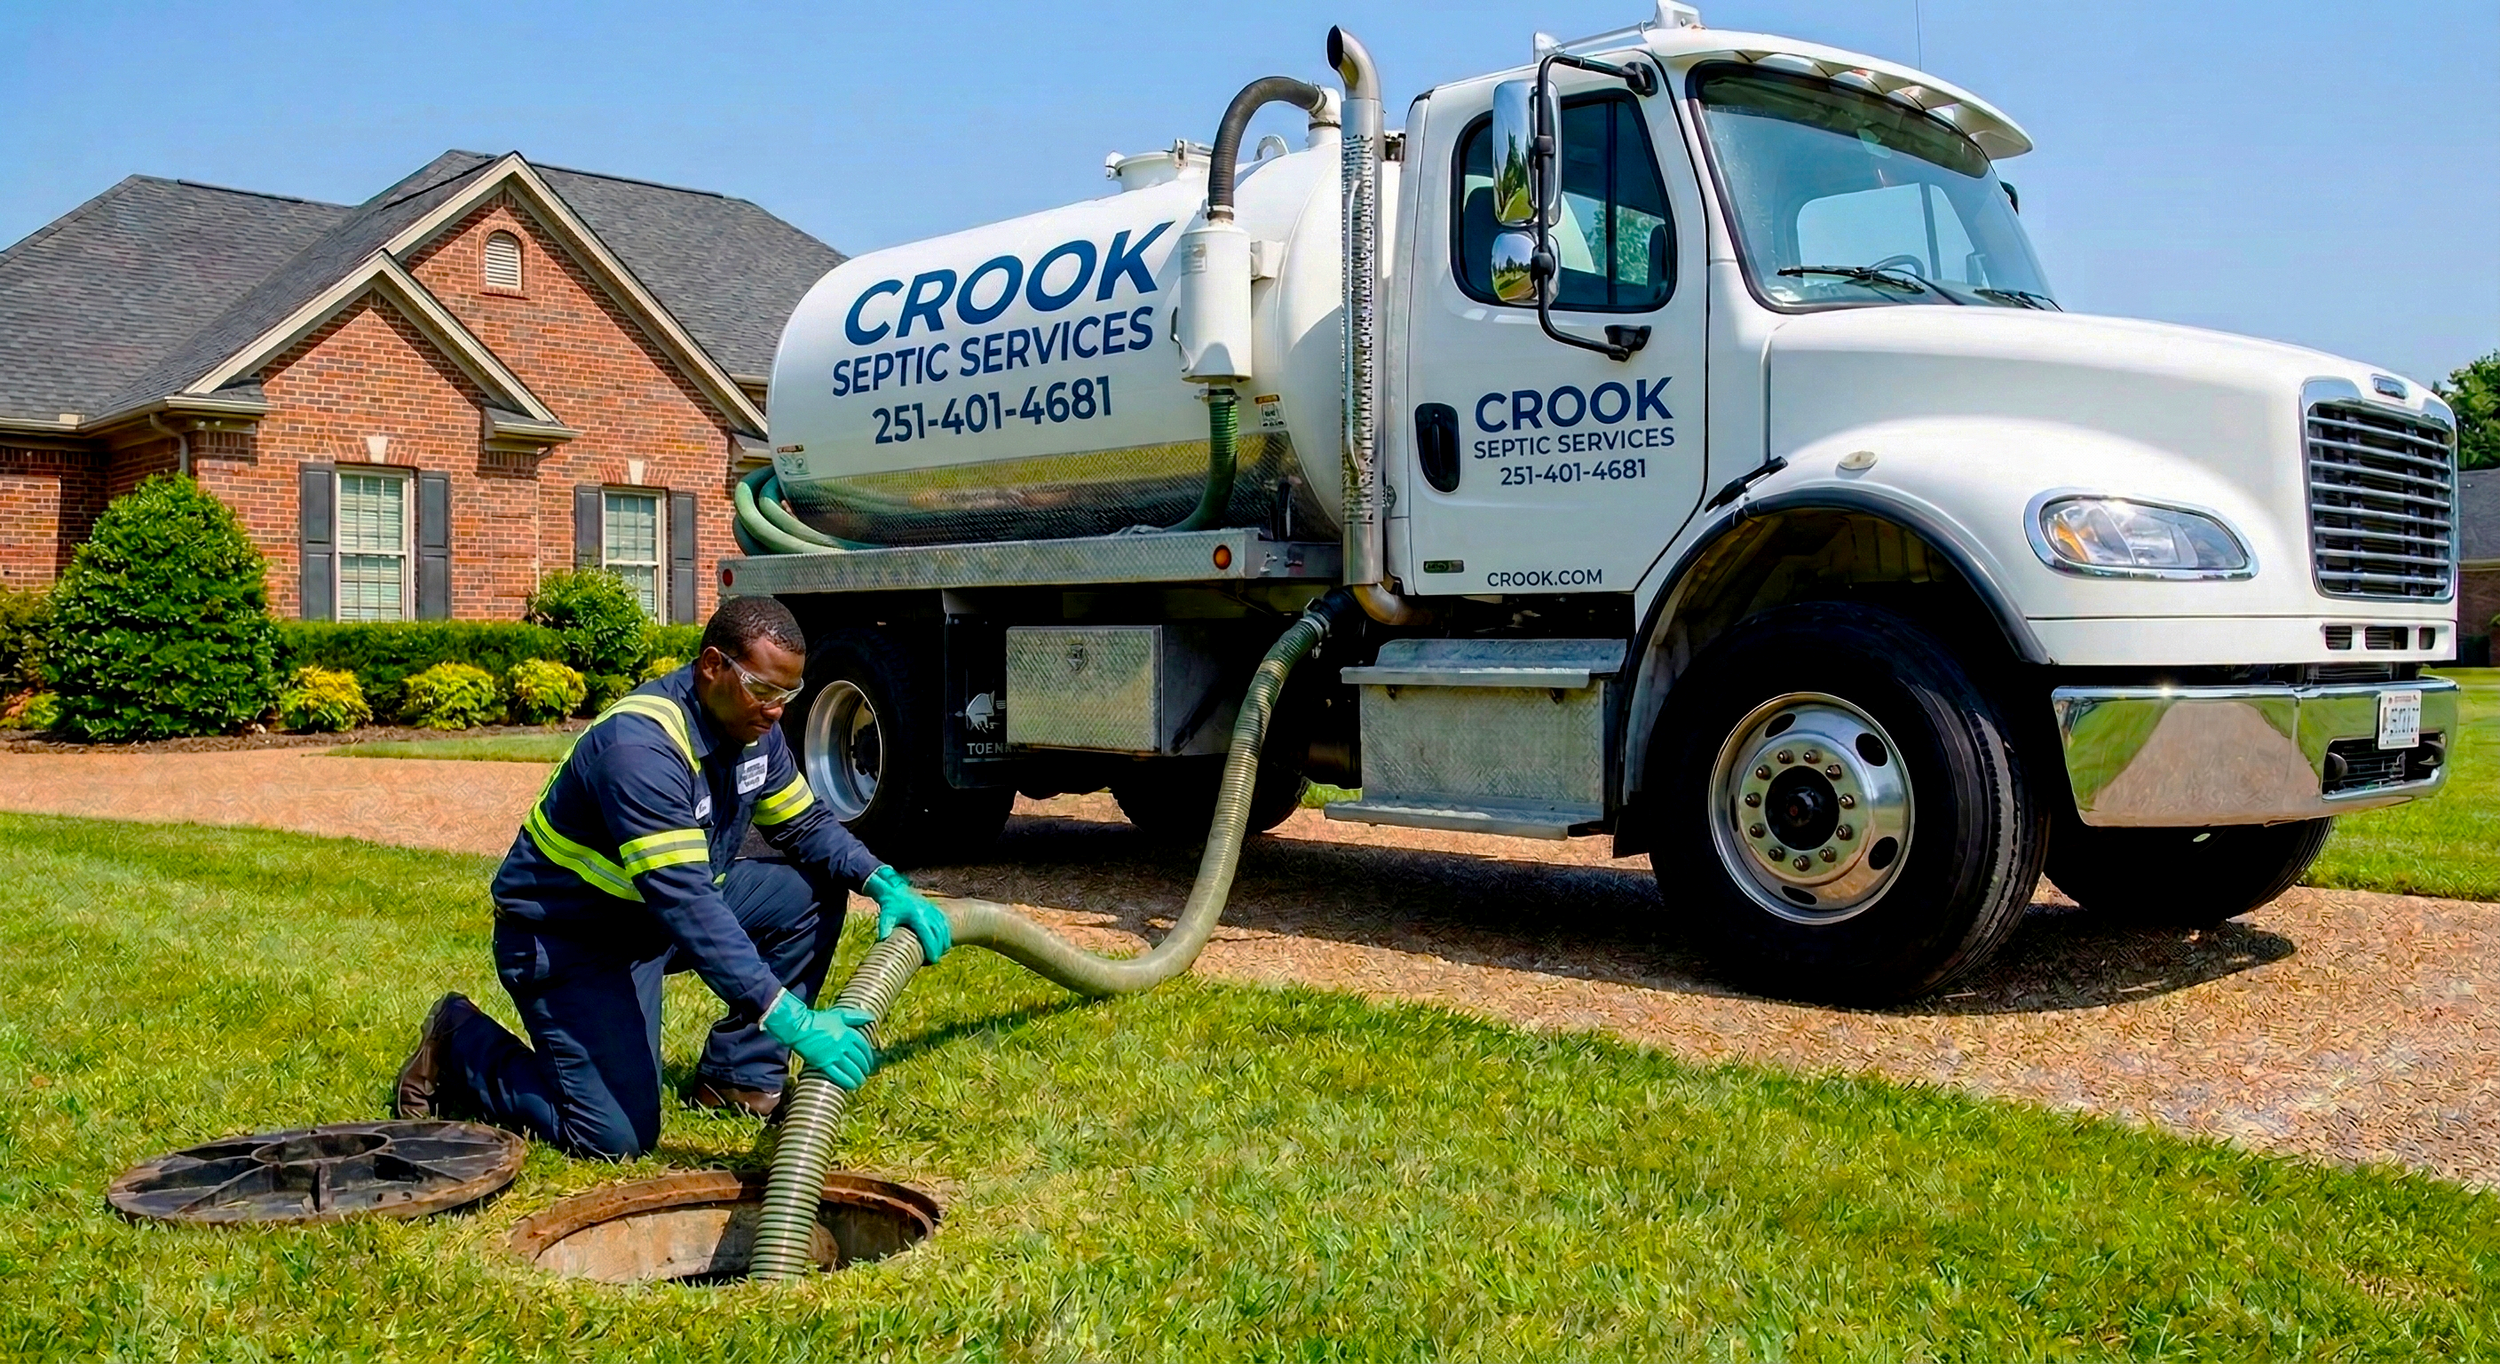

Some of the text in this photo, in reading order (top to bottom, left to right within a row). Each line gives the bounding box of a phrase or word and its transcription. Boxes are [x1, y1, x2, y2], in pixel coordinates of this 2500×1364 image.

[844, 220, 1176, 346] CROOK
[832, 305, 1154, 397] SEPTIC SERVICES
[871, 374, 1112, 445] 251-401-4681
[1474, 375, 1675, 434] CROOK
[1473, 426, 1676, 460] SEPTIC SERVICES
[1499, 457, 1647, 487] 251-401-4681
[1486, 568, 1603, 588] CROOK.COM
